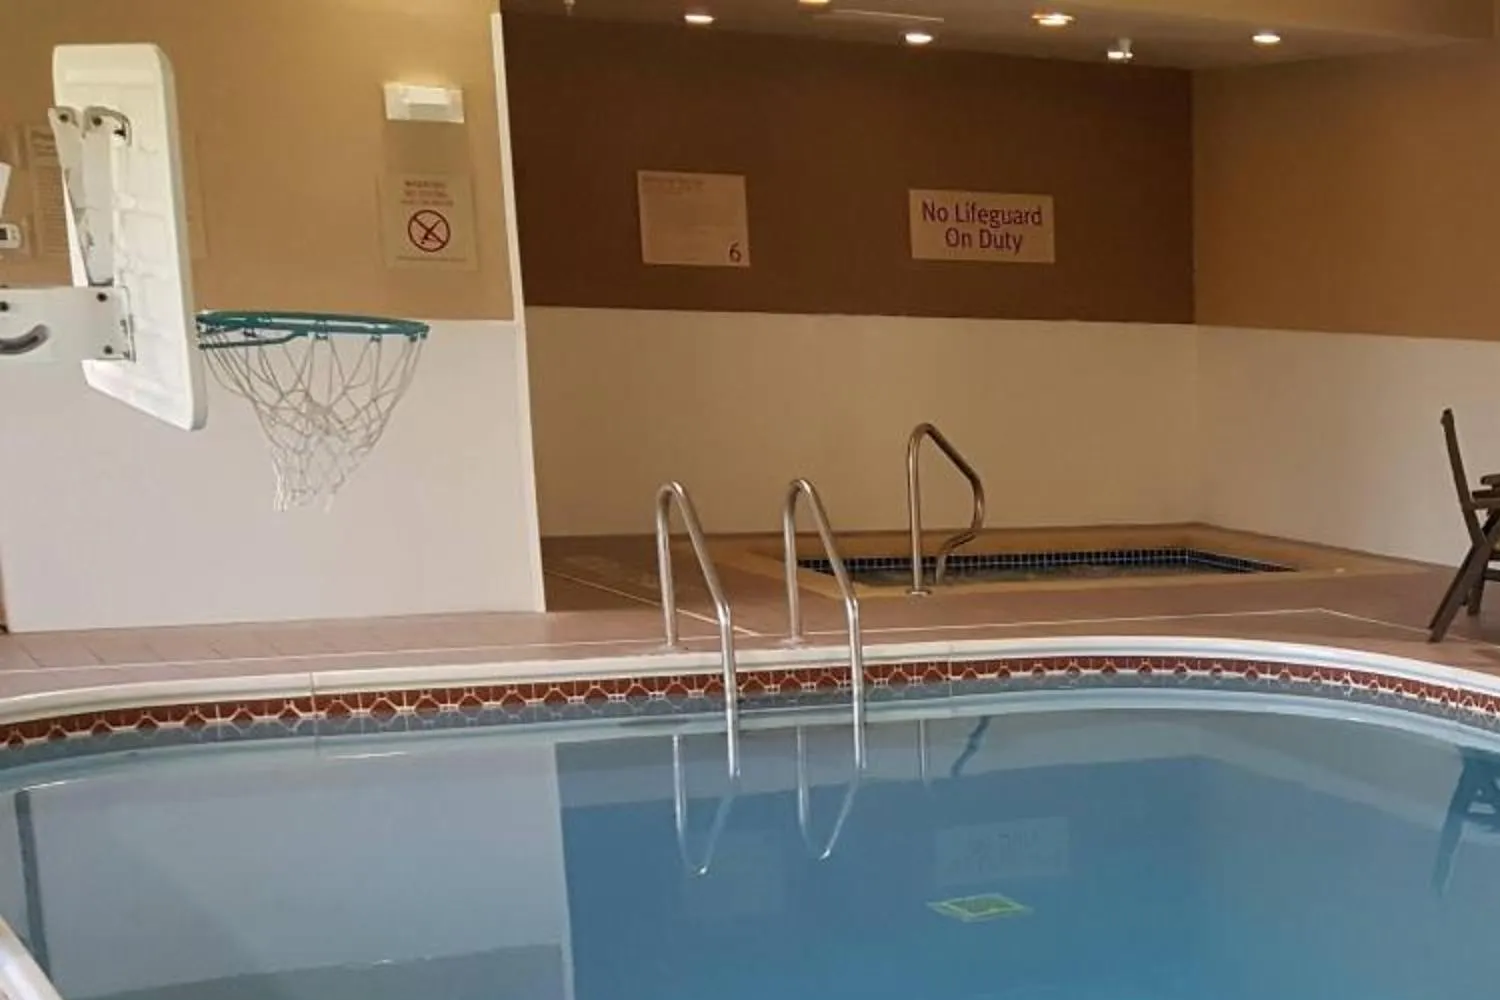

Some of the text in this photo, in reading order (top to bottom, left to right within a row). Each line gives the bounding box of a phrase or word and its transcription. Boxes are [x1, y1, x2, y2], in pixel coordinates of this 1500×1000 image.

[922, 200, 1043, 229] No Lifeguard
[729, 241, 742, 263] 6
[945, 227, 1023, 255] On Duty
